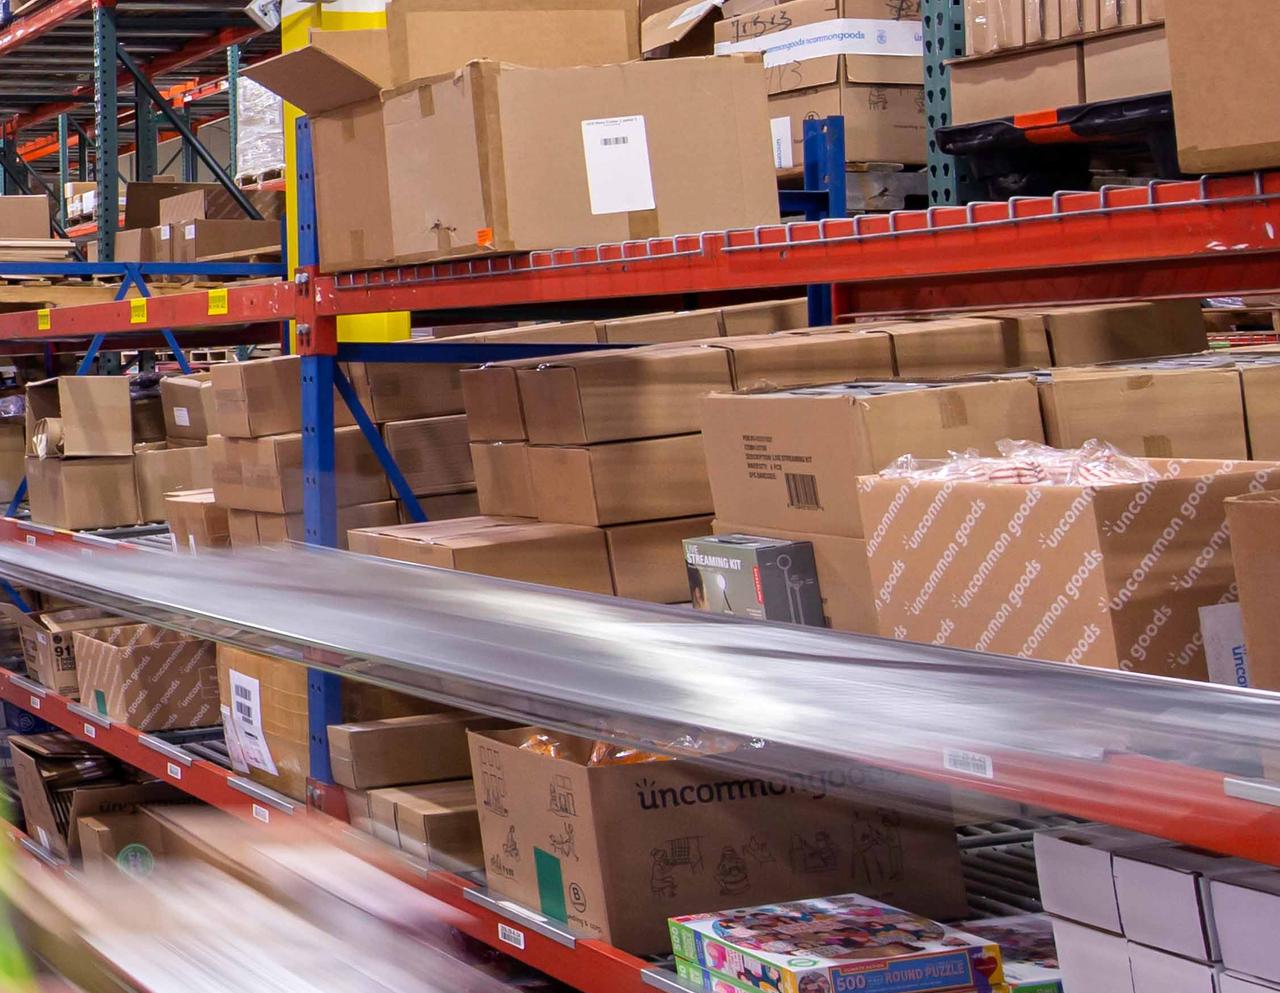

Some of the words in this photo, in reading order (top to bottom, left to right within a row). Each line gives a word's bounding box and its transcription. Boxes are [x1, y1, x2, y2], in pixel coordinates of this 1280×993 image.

[685, 543, 699, 555] LIVE
[687, 553, 729, 570] STREAMING
[728, 559, 742, 571] KIT
[910, 542, 959, 616] uncommon
[954, 498, 987, 547] goods
[958, 531, 1012, 609] uncommon
[1007, 485, 1042, 537] goods
[1109, 516, 1184, 611] uncommon
[879, 558, 906, 604] goods
[1008, 558, 1042, 609] goods
[1065, 548, 1104, 600] goods
[1130, 603, 1173, 661] goods
[1231, 643, 1249, 688] unco
[836, 974, 867, 992] 500
[884, 968, 924, 984] ROUND
[924, 959, 966, 978] PUZZLE
